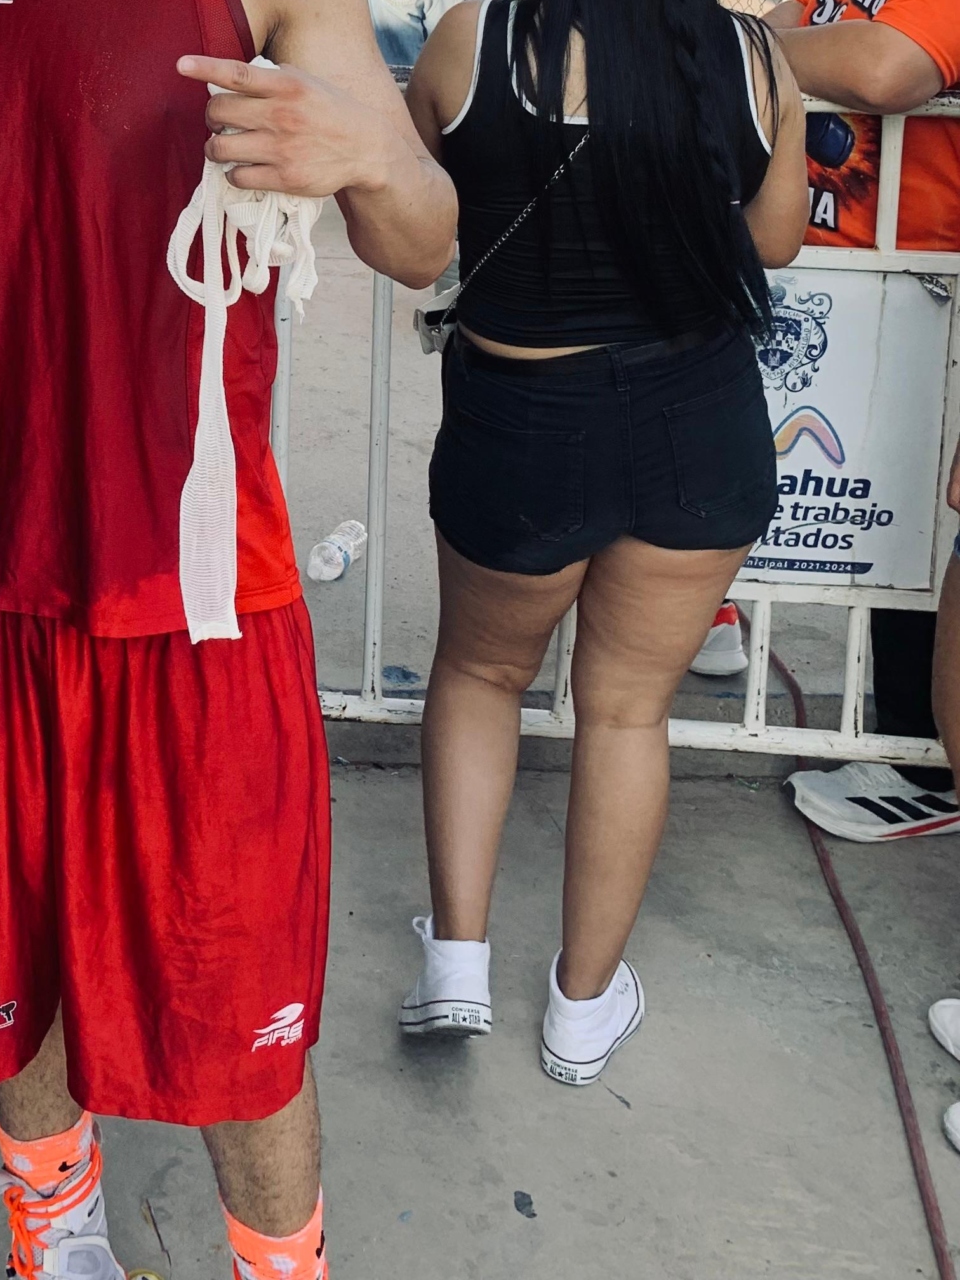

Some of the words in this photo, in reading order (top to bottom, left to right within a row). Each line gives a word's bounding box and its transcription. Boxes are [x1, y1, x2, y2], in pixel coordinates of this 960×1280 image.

[790, 501, 894, 531] trabajo
[754, 526, 855, 551] ltados
[793, 561, 853, 572] 2021-2024
[251, 1018, 305, 1053] FIRE
